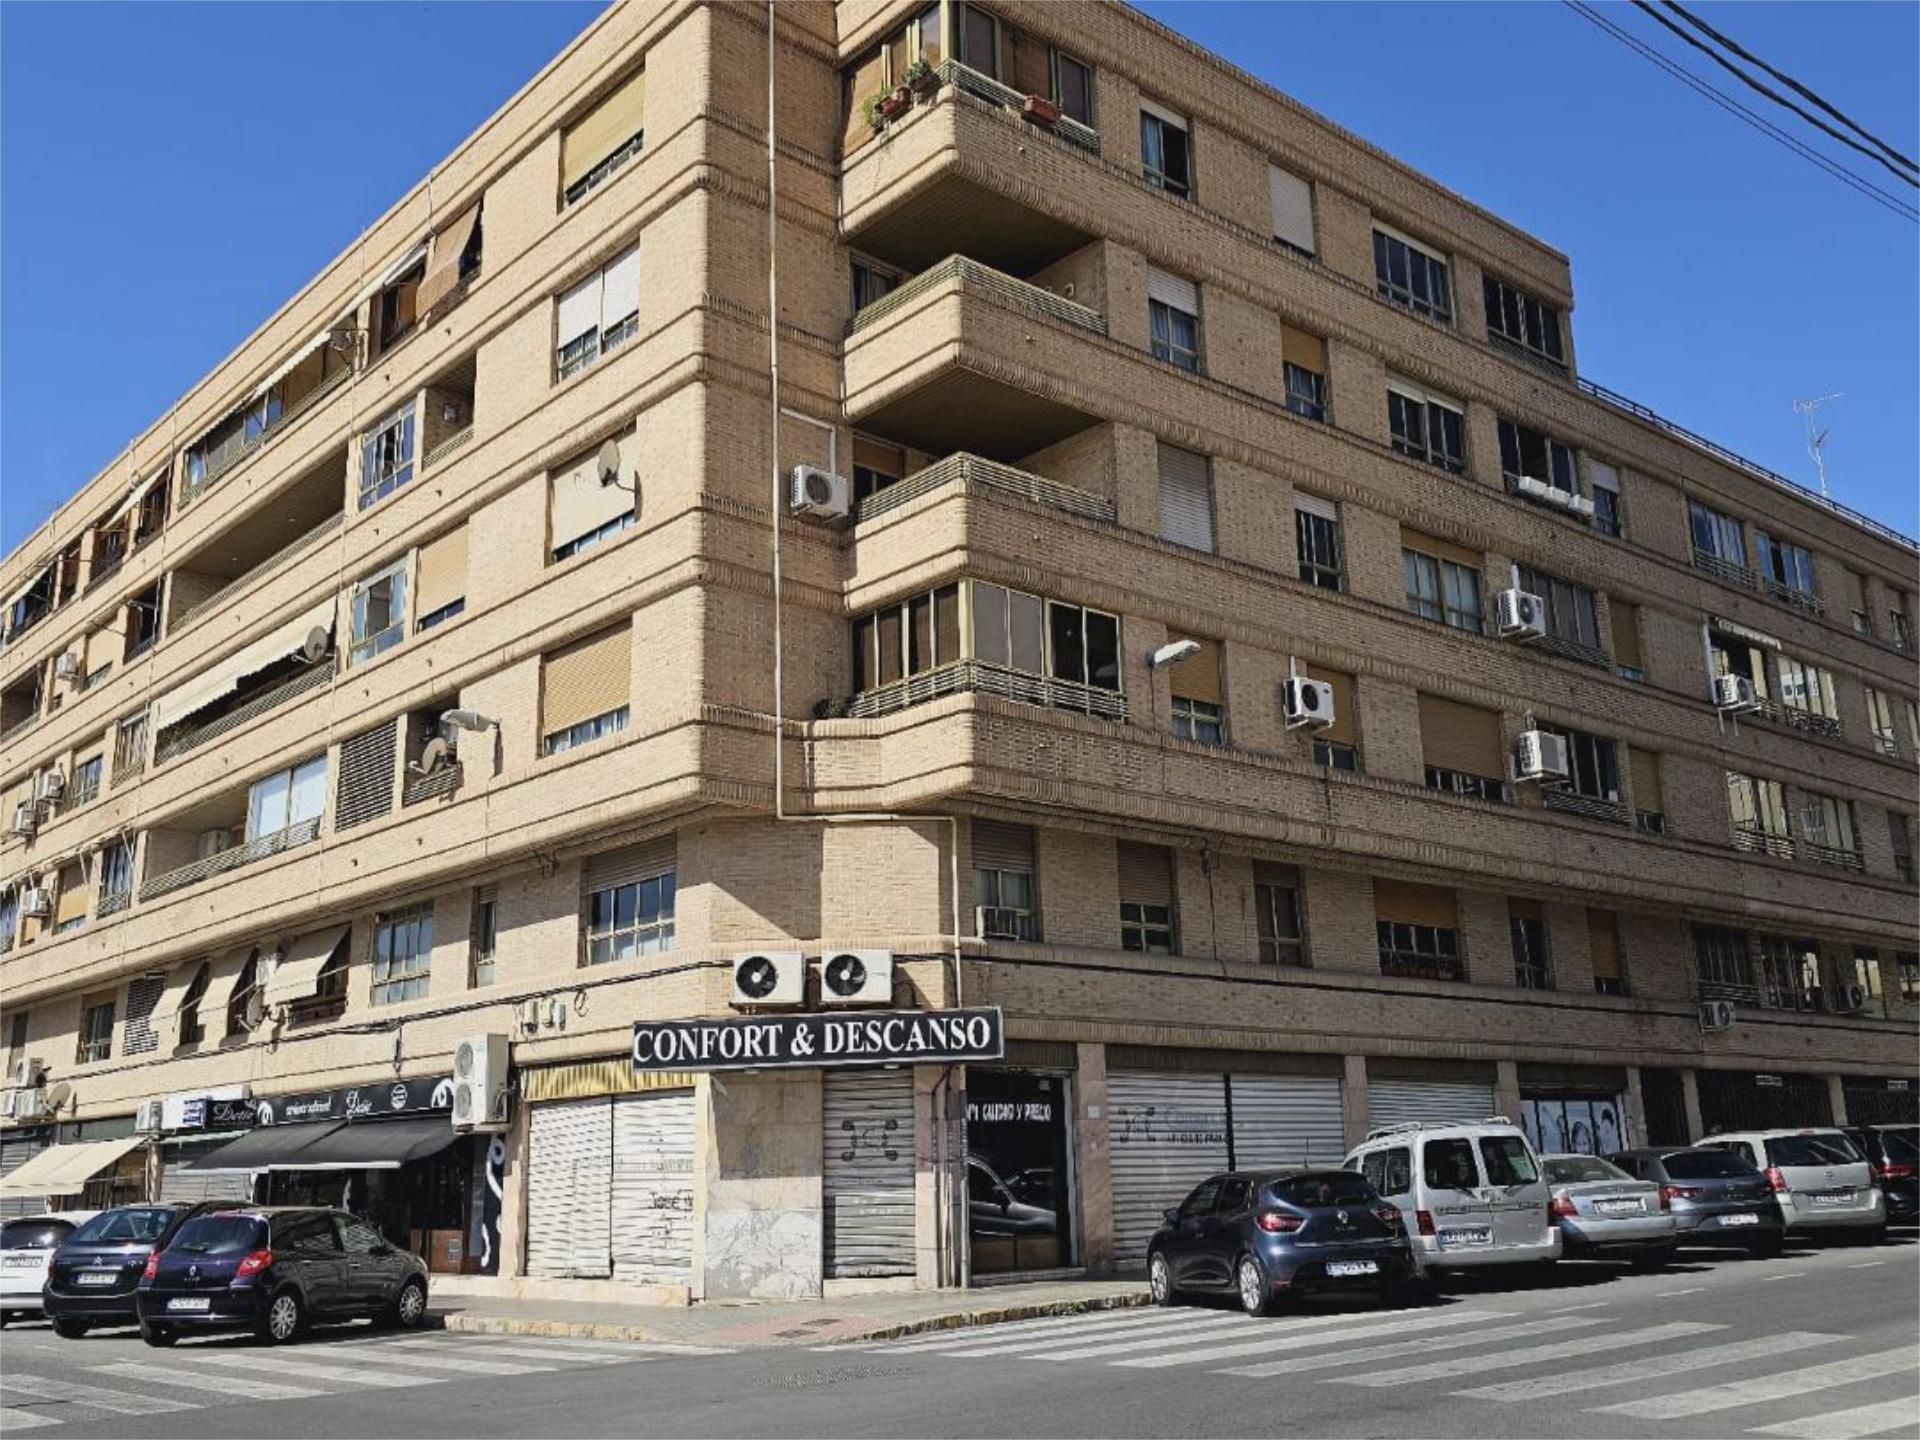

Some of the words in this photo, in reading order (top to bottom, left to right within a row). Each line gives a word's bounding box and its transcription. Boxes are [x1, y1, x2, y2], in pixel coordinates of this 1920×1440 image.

[634, 1024, 783, 1063] CONFORT
[790, 1023, 816, 1056] &
[823, 1015, 991, 1054] DESCANSO
[1024, 1103, 1051, 1122] PRECIO
